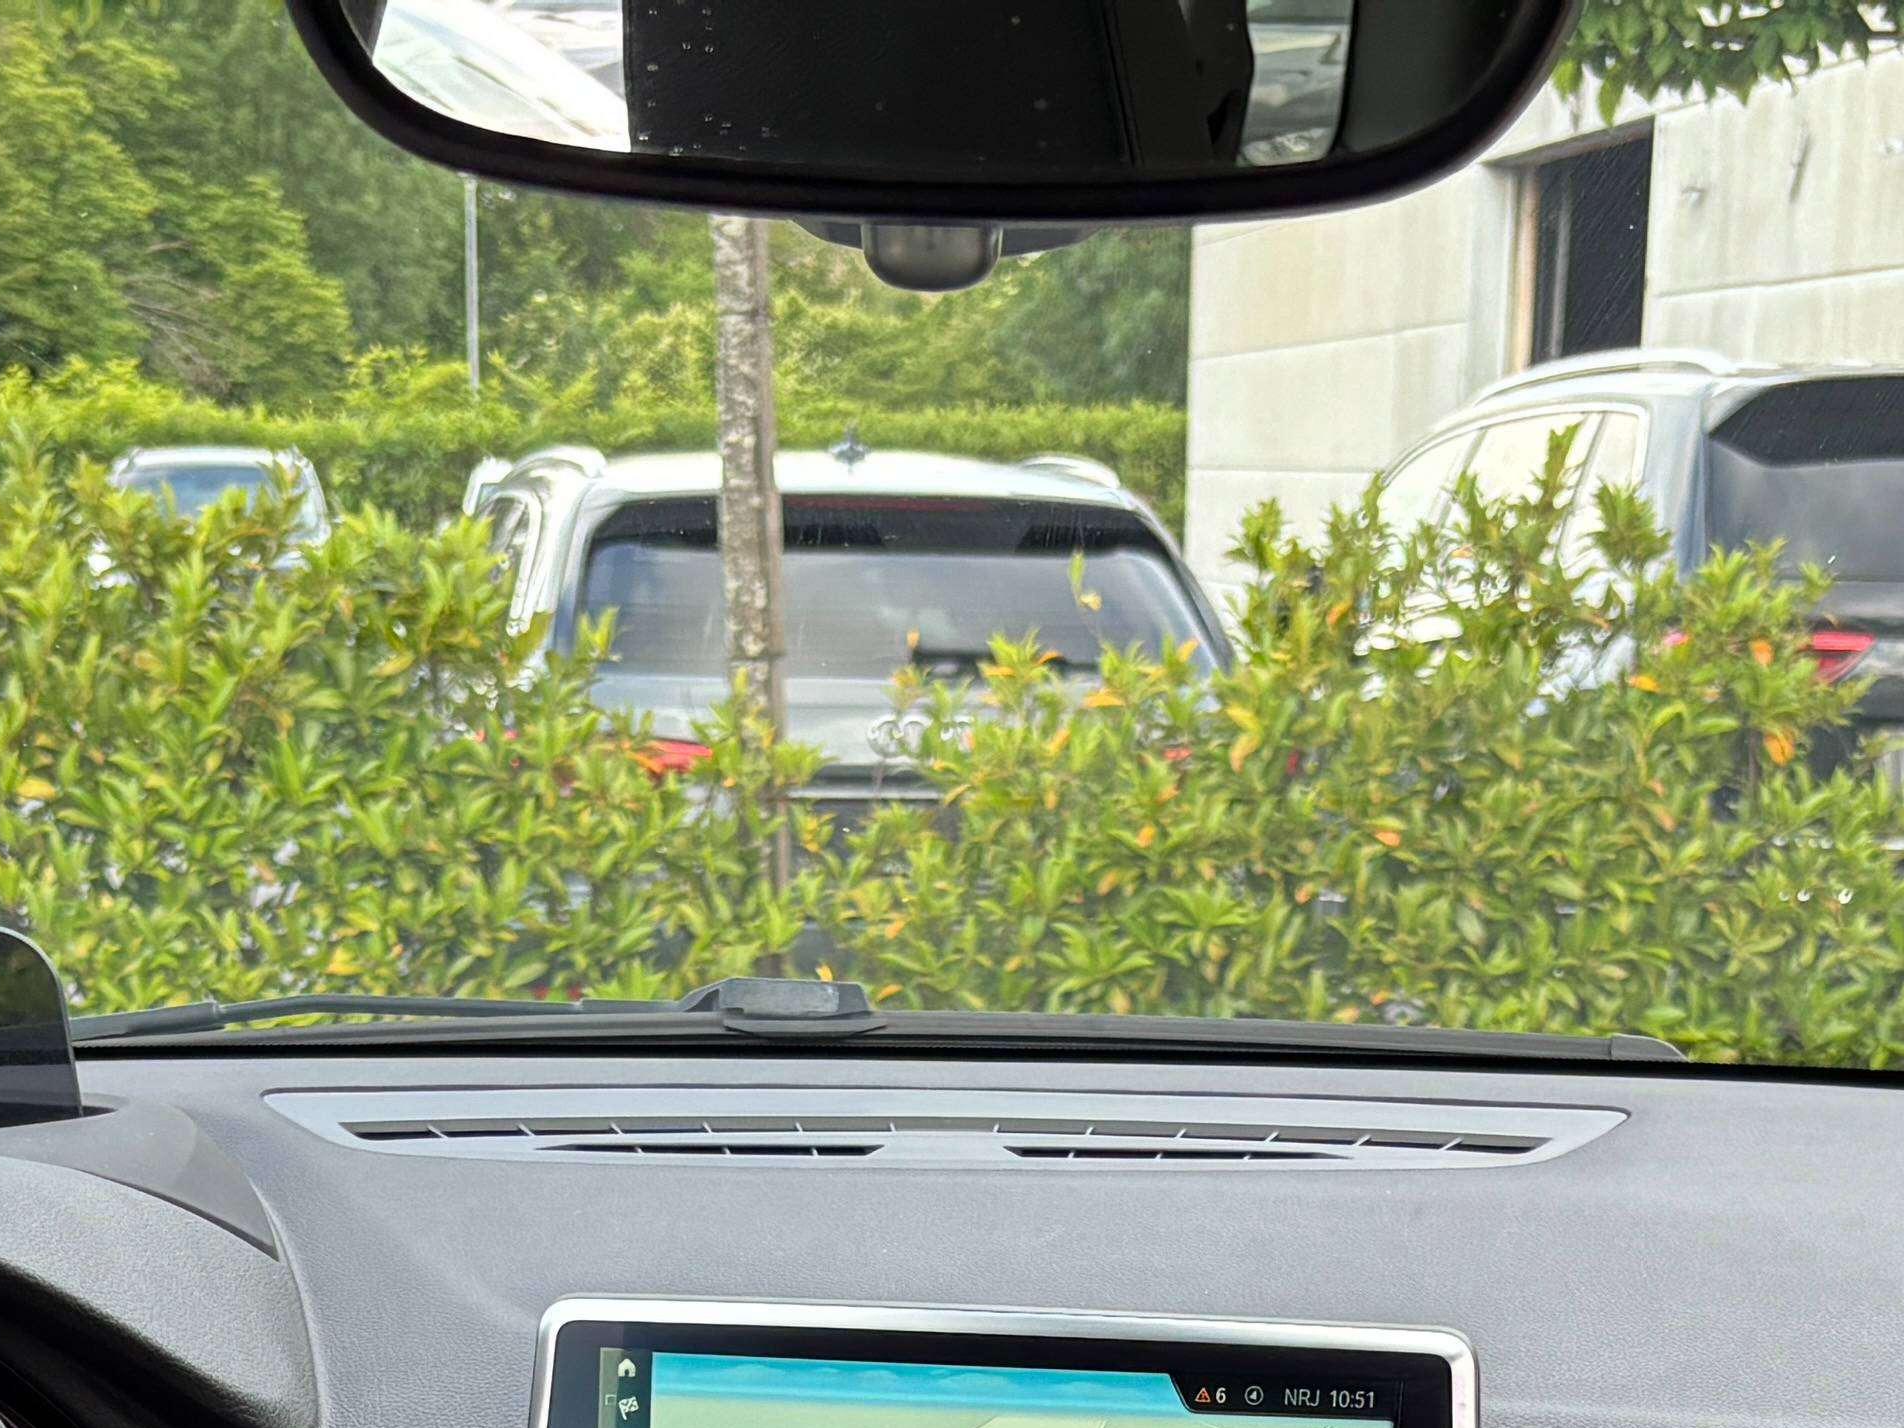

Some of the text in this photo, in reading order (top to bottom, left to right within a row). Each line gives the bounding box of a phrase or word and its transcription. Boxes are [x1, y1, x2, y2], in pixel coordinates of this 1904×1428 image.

[1215, 1387, 1226, 1403] 6
[1284, 1388, 1375, 1408] NRJ 10:51
